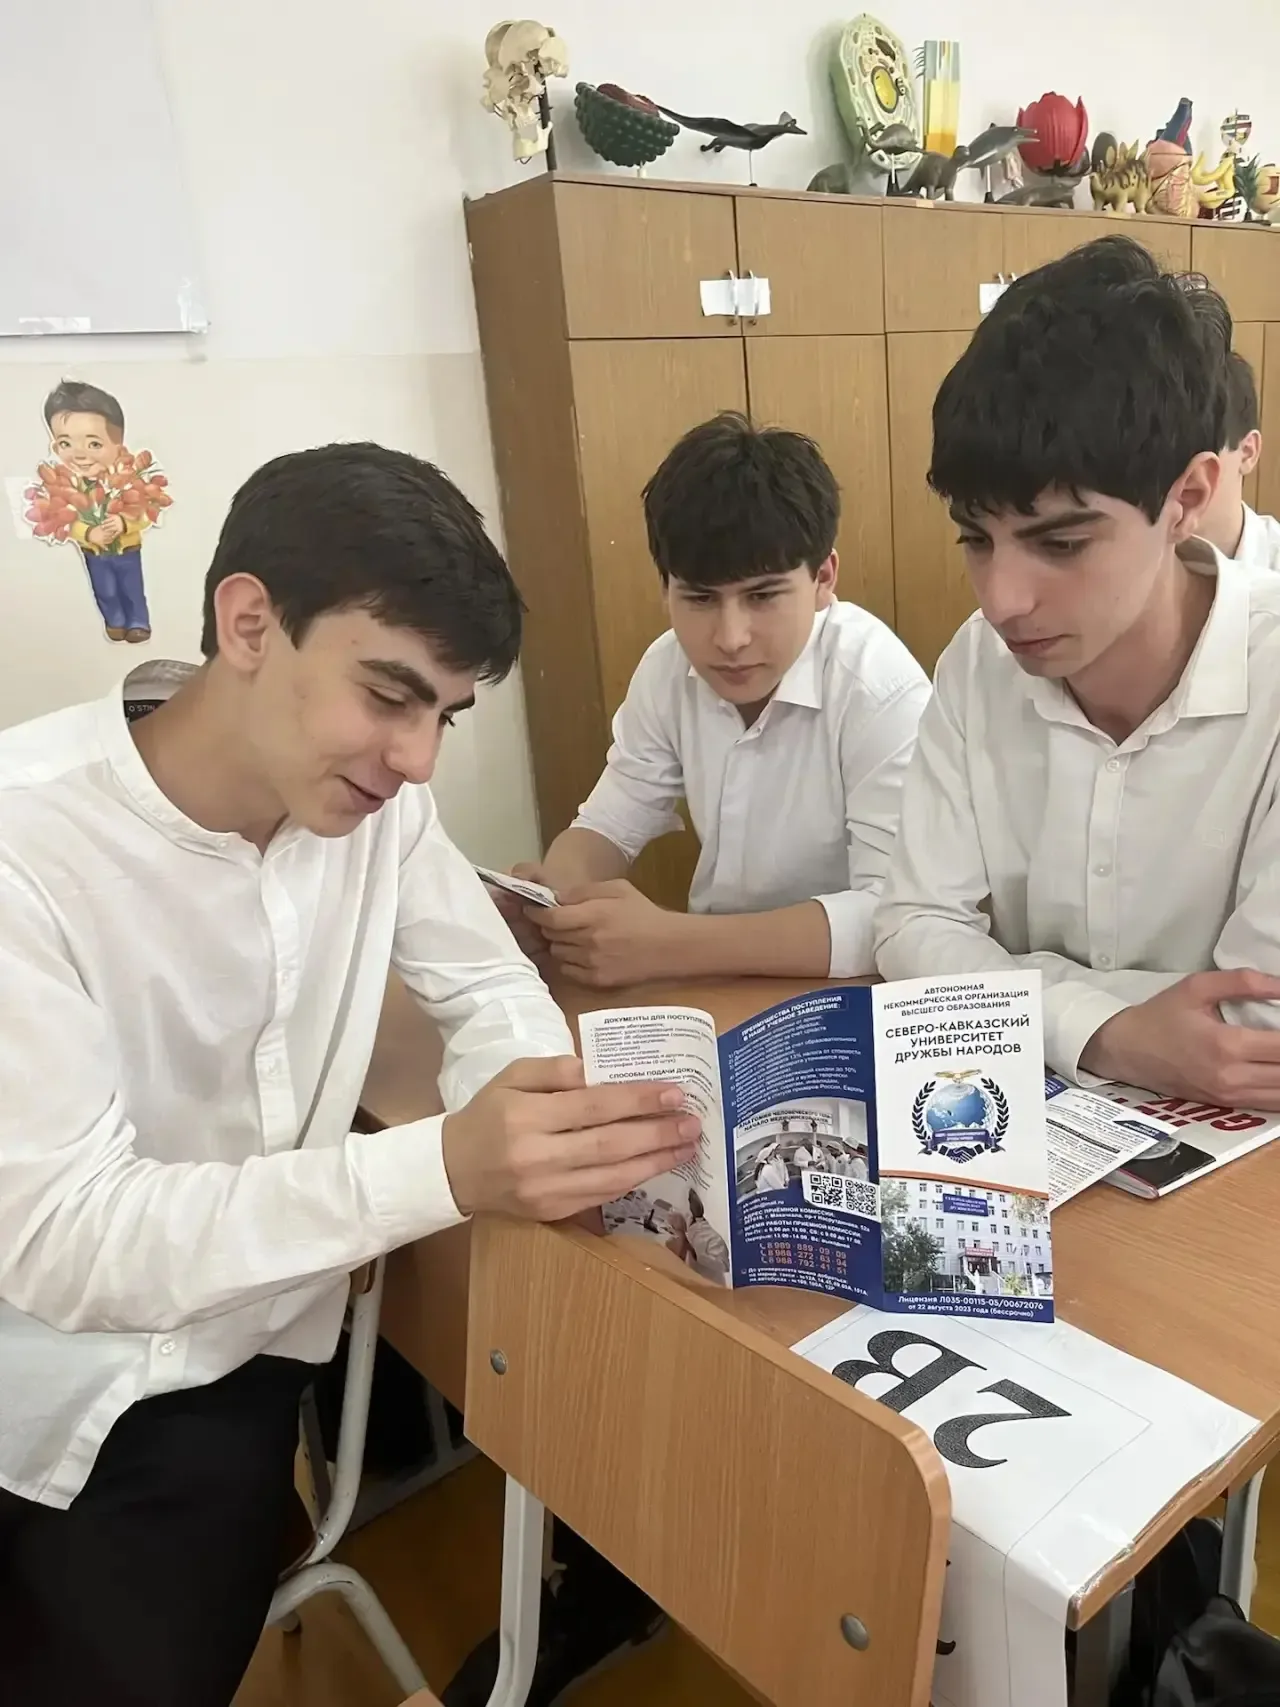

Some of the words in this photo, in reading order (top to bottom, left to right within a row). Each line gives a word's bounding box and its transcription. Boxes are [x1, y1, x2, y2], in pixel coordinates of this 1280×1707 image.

[924, 983, 985, 995] АВТОНОМНАЯ
[791, 996, 843, 1011] ПОСТУПЛЕНИЯ
[883, 995, 963, 1010] НЕКОММЕРЧЕСКАЯ
[965, 990, 1029, 1001] ОРГАНИЗАЦИЯ
[901, 1005, 945, 1017] ВЫСШЕГО
[946, 1001, 1011, 1011] ОБРАЗОВАНИЯ
[604, 1015, 649, 1024] ДОКУМЕНТЫ
[885, 1014, 1030, 1038] СЕВЕРО-КАВКАЗСКИЙ
[910, 1031, 1004, 1048] УНИВЕРСИТЕТ
[895, 1048, 952, 1064] ДРУЖБЫ
[956, 1043, 1022, 1056] НАРОДОВ
[608, 1071, 645, 1080] СПОСОБЫ
[646, 1068, 675, 1076] ПОДАЧИ
[898, 1296, 938, 1304] Лицензия
[972, 1306, 989, 1314] года
